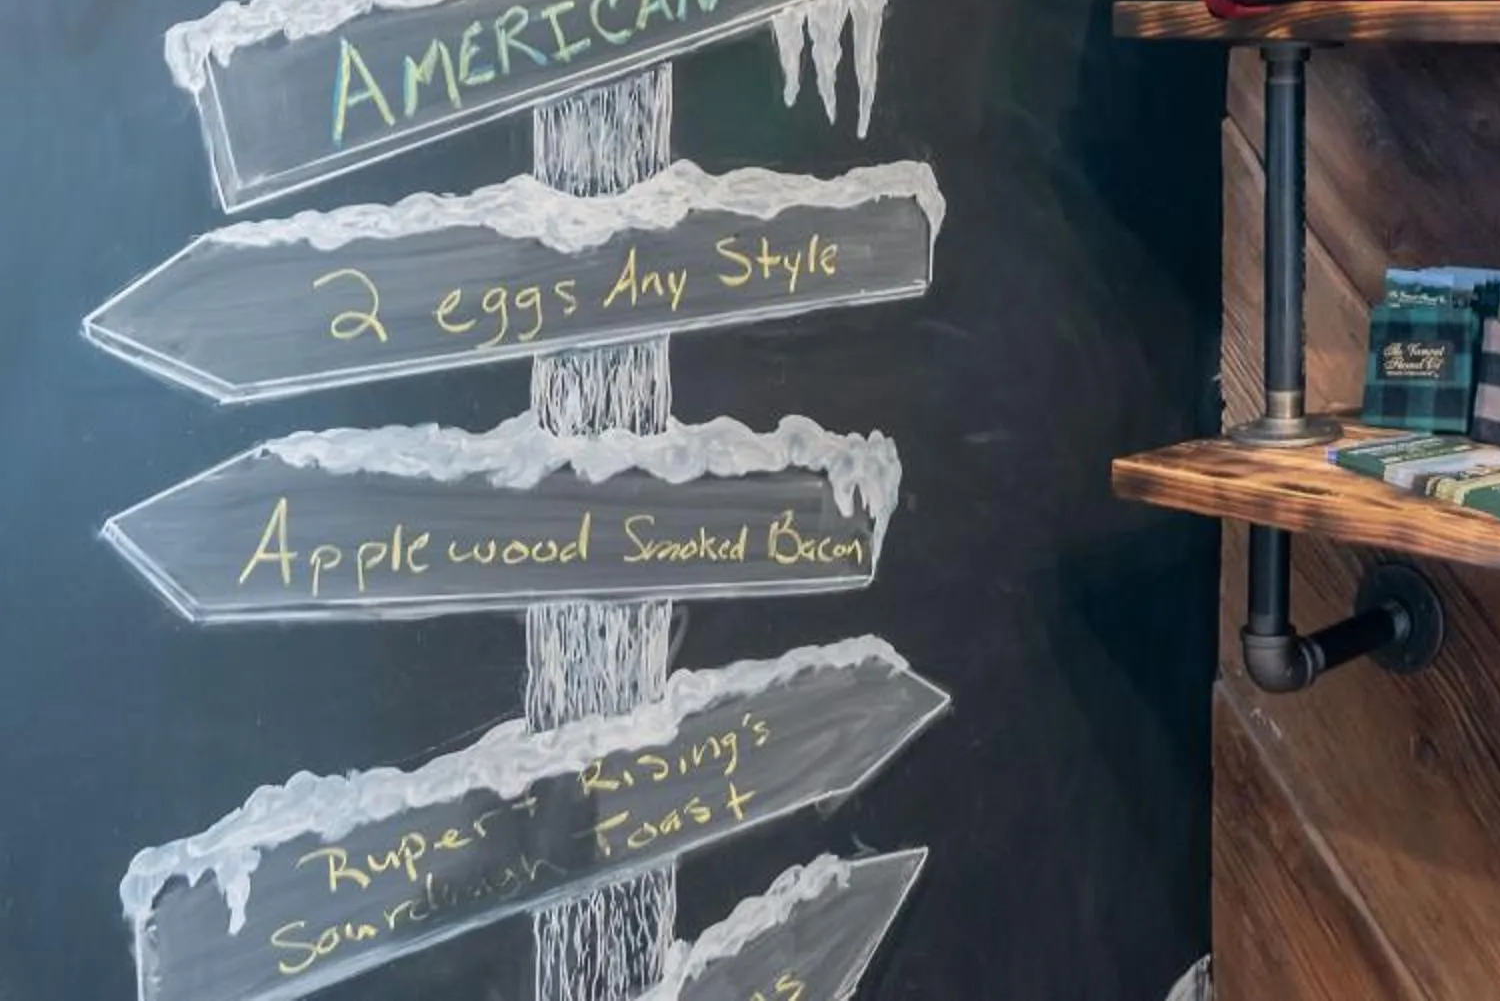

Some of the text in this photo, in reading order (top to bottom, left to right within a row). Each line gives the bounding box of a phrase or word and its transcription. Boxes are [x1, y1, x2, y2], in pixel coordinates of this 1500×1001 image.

[313, 234, 838, 349] 2 eggs Any Style
[623, 514, 748, 565] Smoked
[766, 509, 867, 566] Bacon
[577, 713, 771, 797] Rising's
[574, 782, 757, 857] Toast
